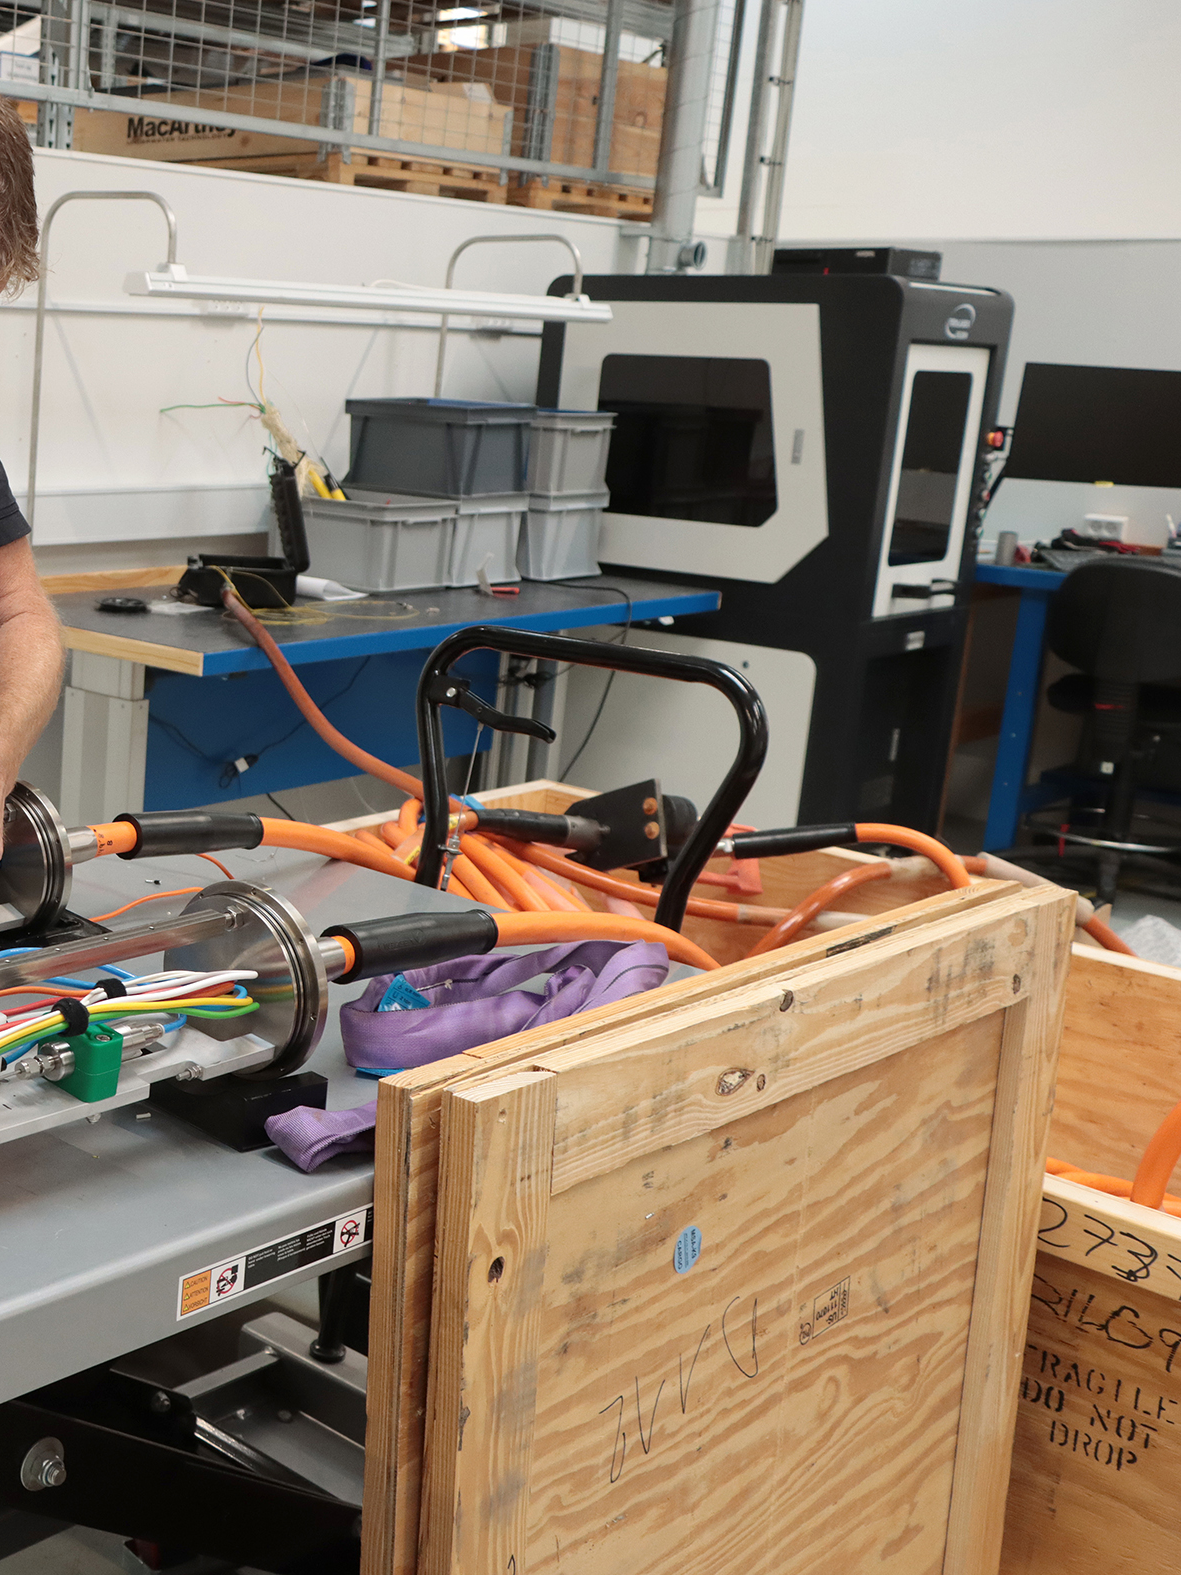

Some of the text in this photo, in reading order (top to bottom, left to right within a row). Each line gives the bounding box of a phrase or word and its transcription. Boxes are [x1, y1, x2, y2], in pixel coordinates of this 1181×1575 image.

[1023, 1377, 1159, 1449] DO NOT
[1050, 1420, 1138, 1471] DROP
